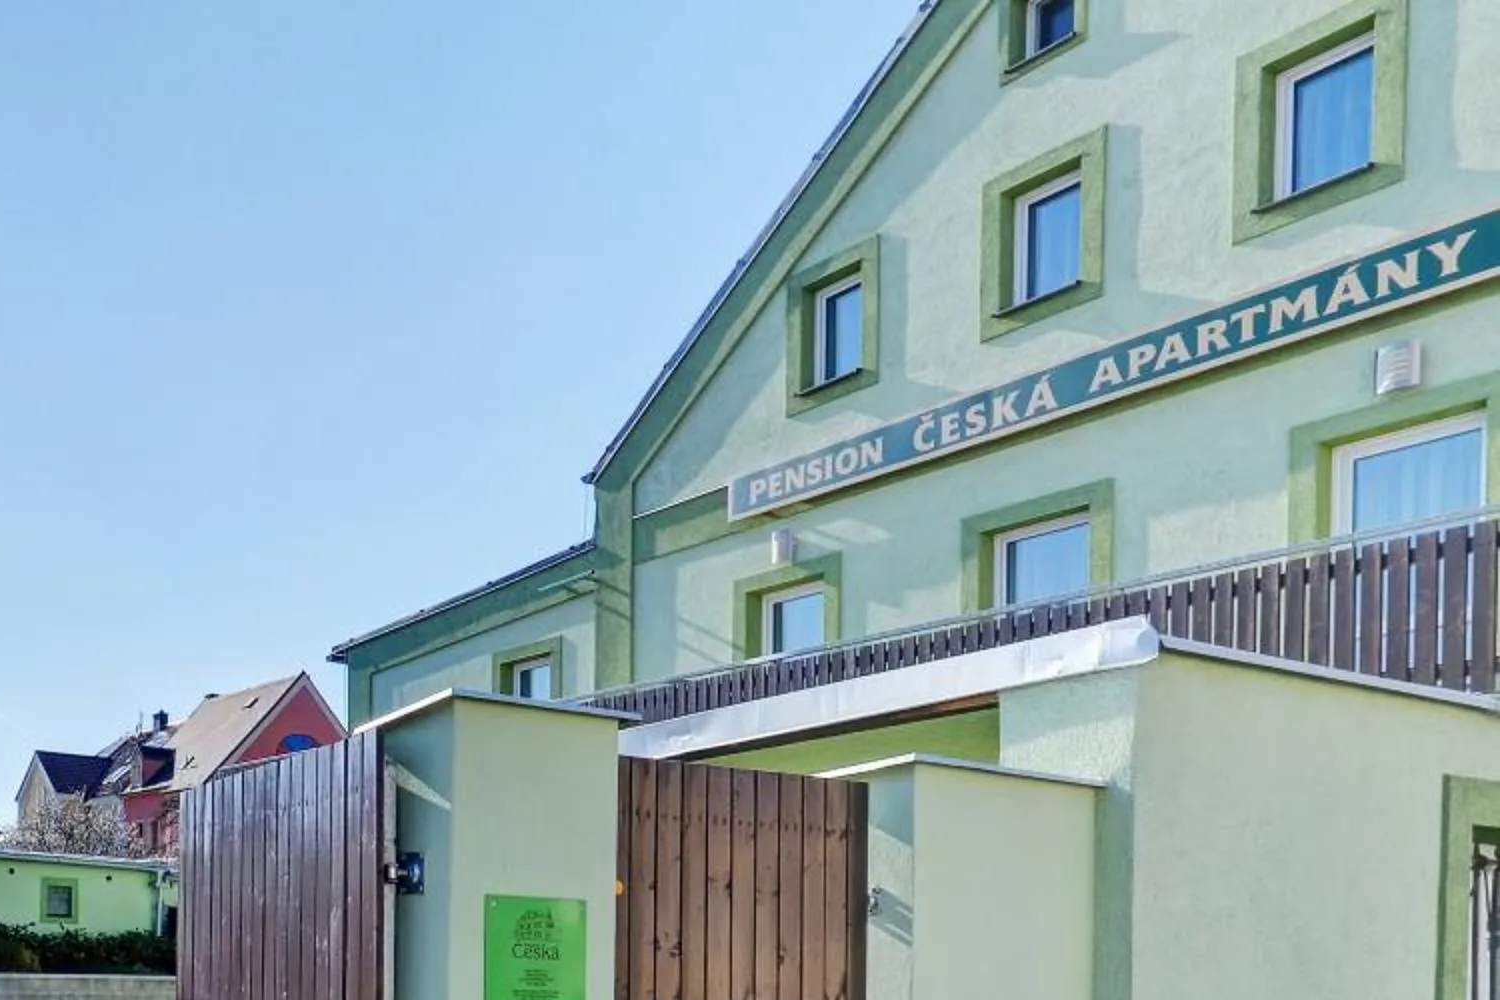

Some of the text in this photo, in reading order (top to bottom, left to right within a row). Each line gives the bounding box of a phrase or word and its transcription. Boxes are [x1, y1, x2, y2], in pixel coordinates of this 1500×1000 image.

[748, 229, 1476, 505] PENSION ČESKÁ APARTMÁNY
